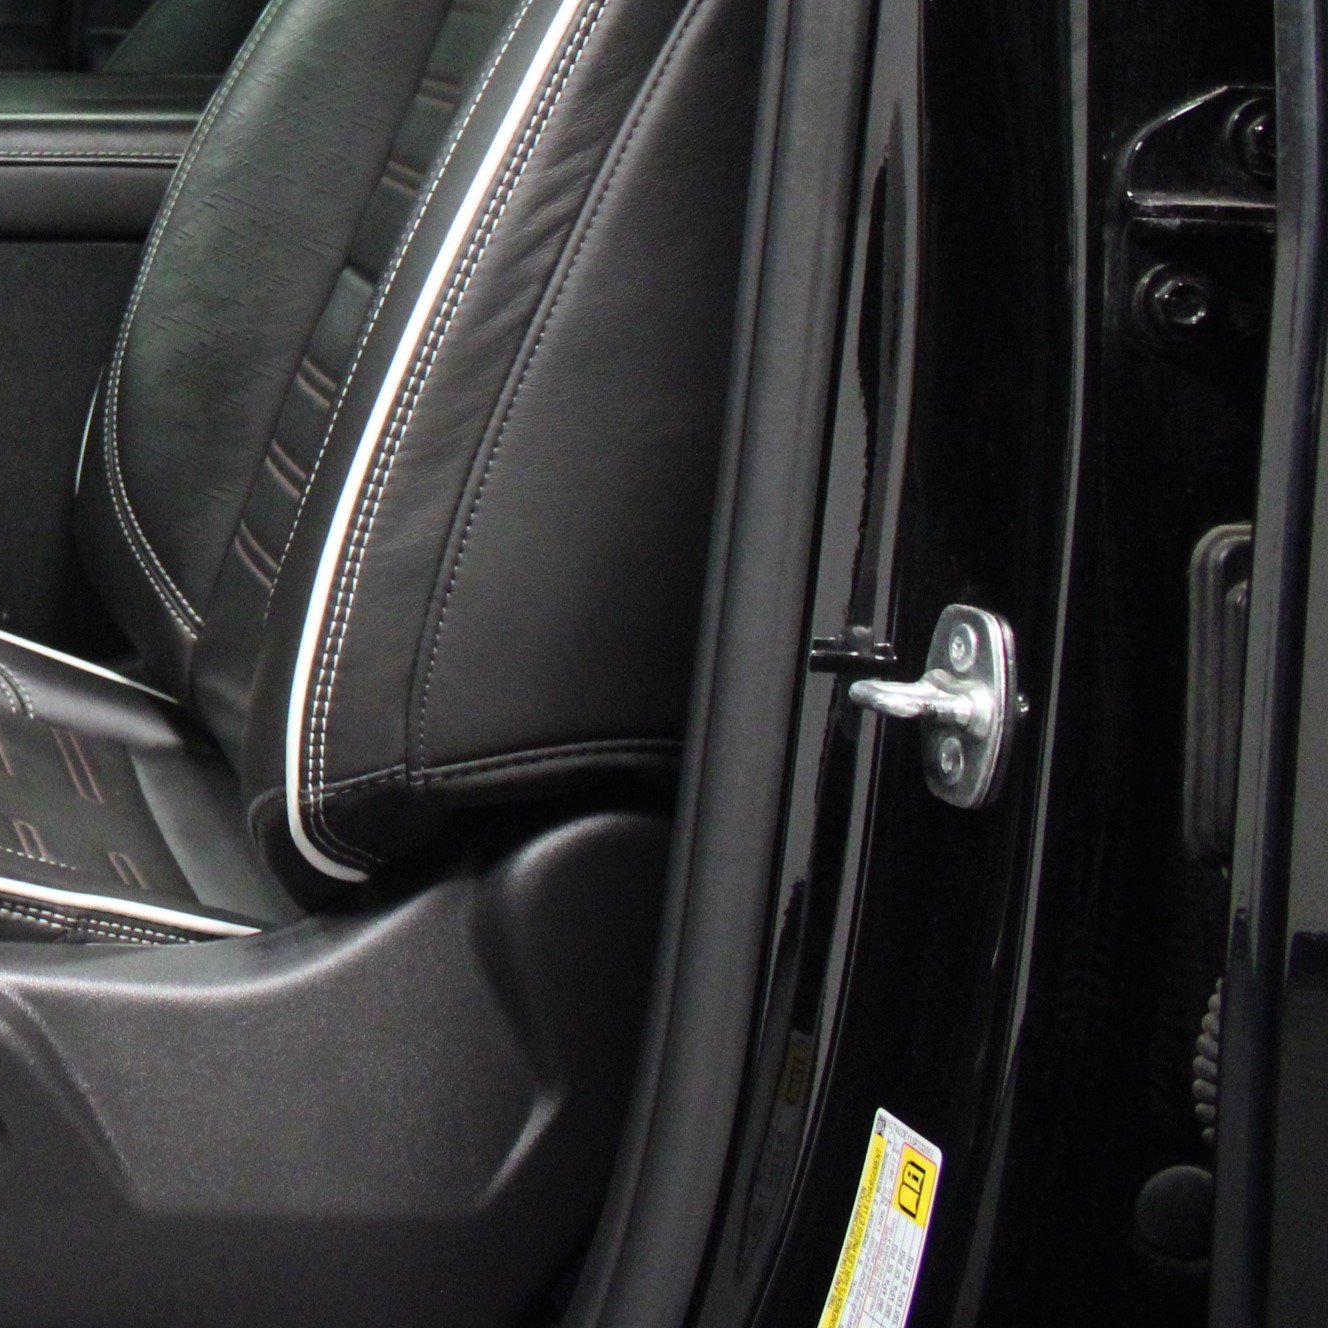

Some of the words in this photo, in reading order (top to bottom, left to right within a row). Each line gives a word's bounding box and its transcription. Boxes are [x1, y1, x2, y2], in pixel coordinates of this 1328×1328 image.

[865, 1146, 883, 1204] CHARGEMENT
[858, 1213, 866, 1227] ET
[833, 1273, 843, 1293] AND
[838, 1238, 853, 1275] LOADING
[849, 1185, 867, 1238] INFORMATION
[851, 1225, 864, 1254] PNEUS
[845, 1251, 856, 1270] LES
[841, 1268, 851, 1288] SUR
